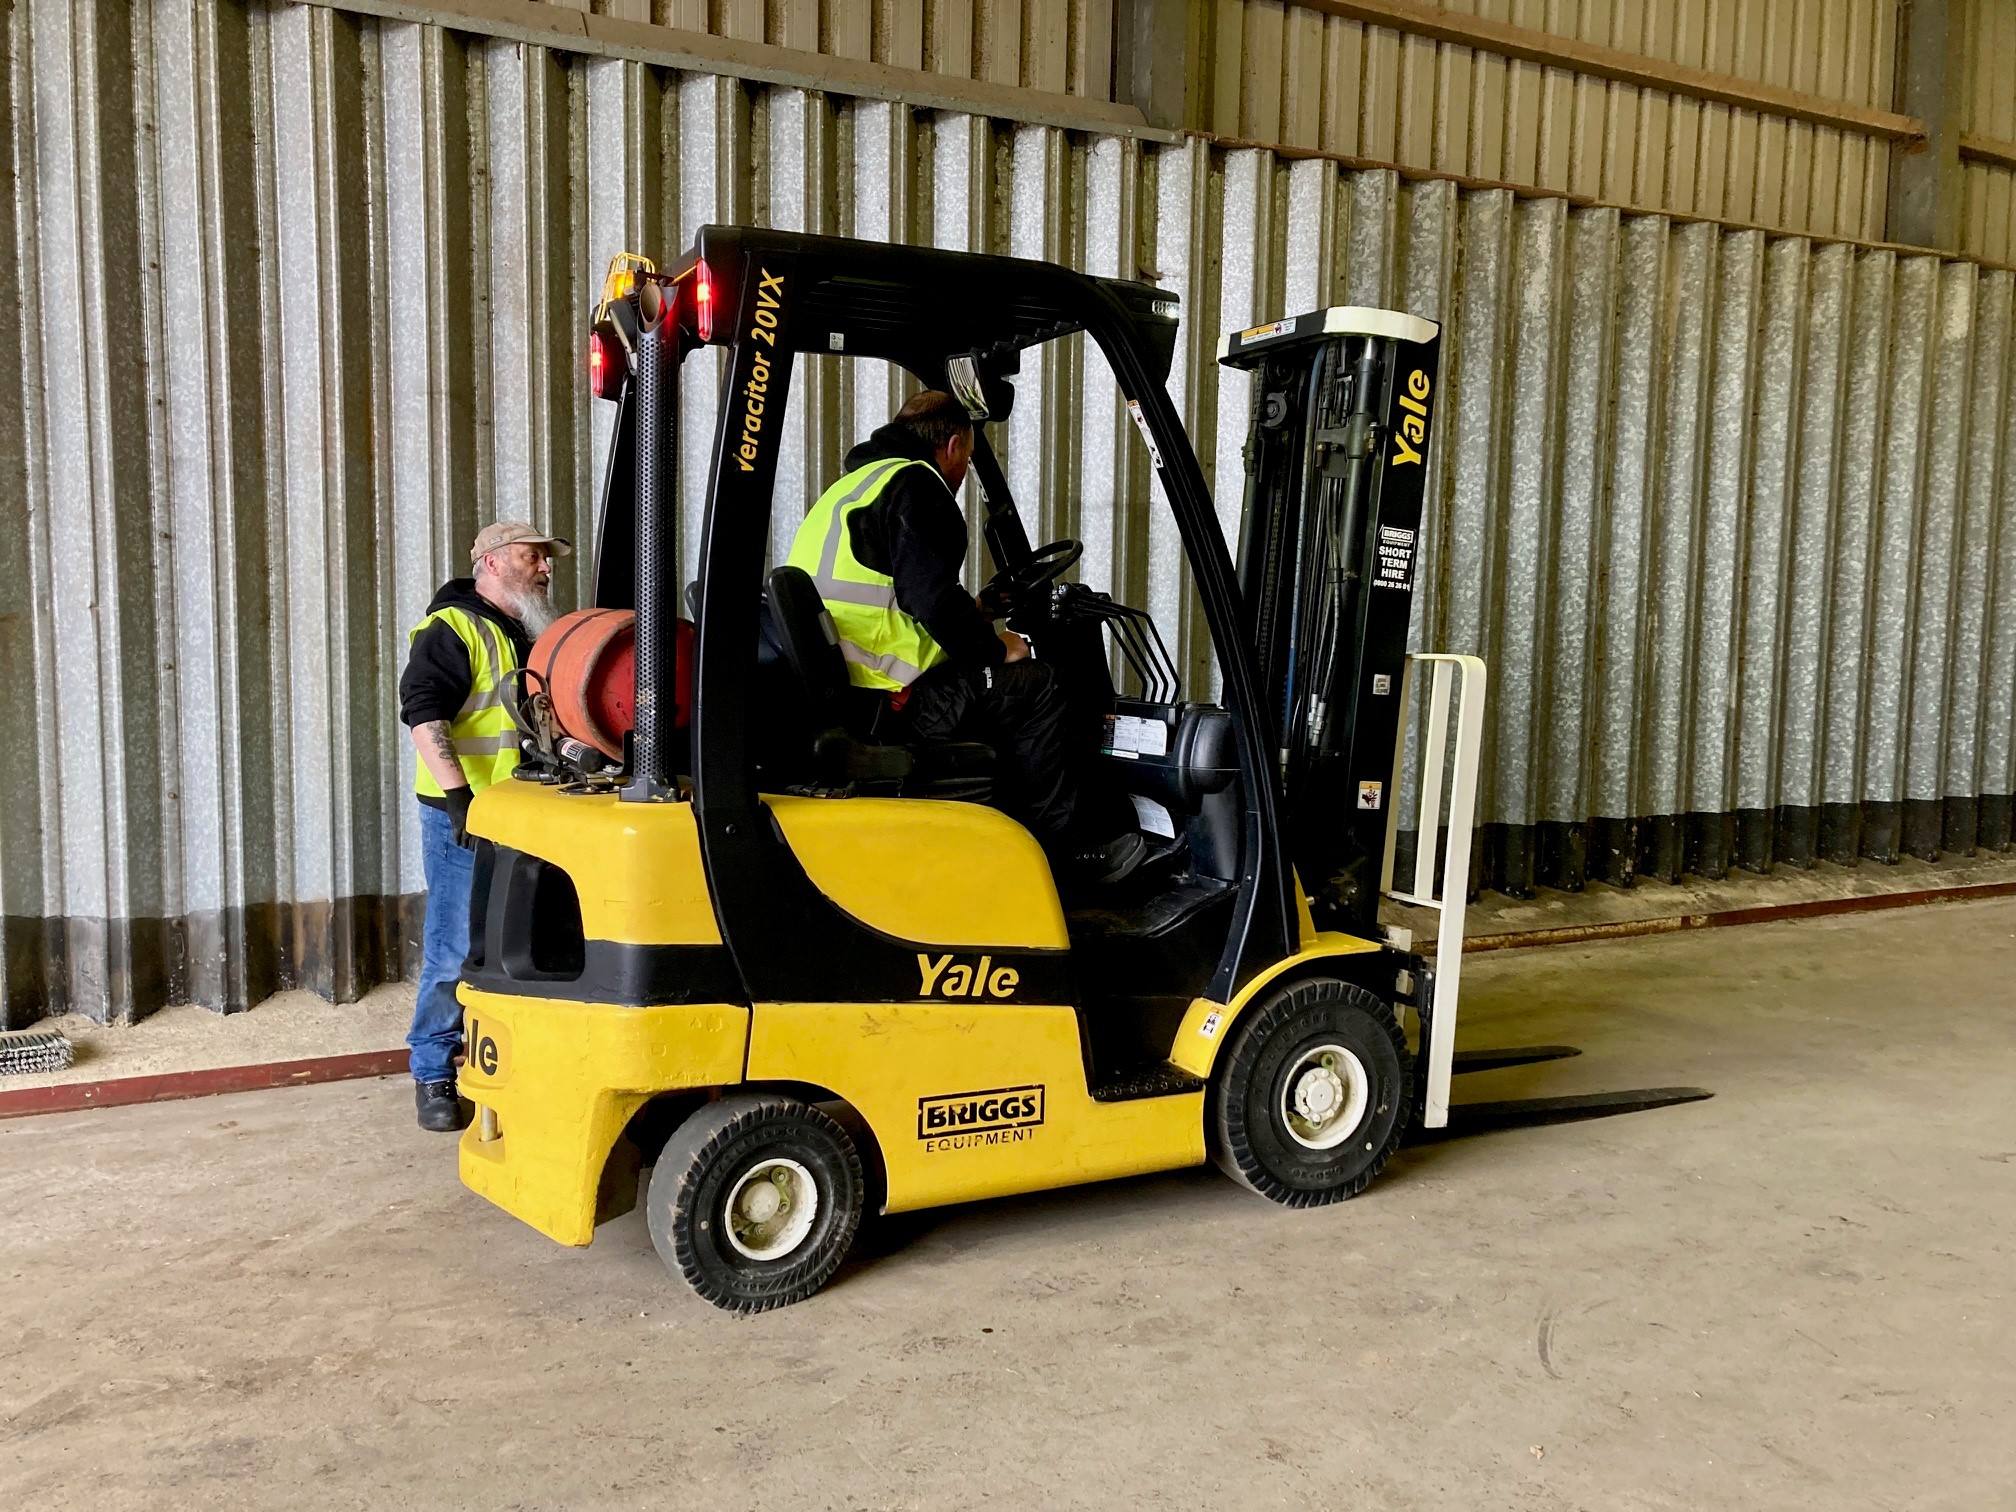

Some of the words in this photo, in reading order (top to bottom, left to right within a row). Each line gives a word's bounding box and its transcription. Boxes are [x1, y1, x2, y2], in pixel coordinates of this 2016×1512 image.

[751, 267, 785, 347] 20VX
[733, 351, 771, 472] Veracitor
[1392, 369, 1430, 466] Yale
[1384, 529, 1412, 540] BRIGGS
[1378, 545, 1412, 559] SHORT
[1381, 557, 1408, 569] TERM
[1381, 568, 1405, 580] HIRE
[917, 953, 1020, 998] Yale
[467, 1018, 498, 1076] le
[927, 1095, 1036, 1129] BRIGGS
[926, 1128, 1033, 1153] EQUIPMENT
